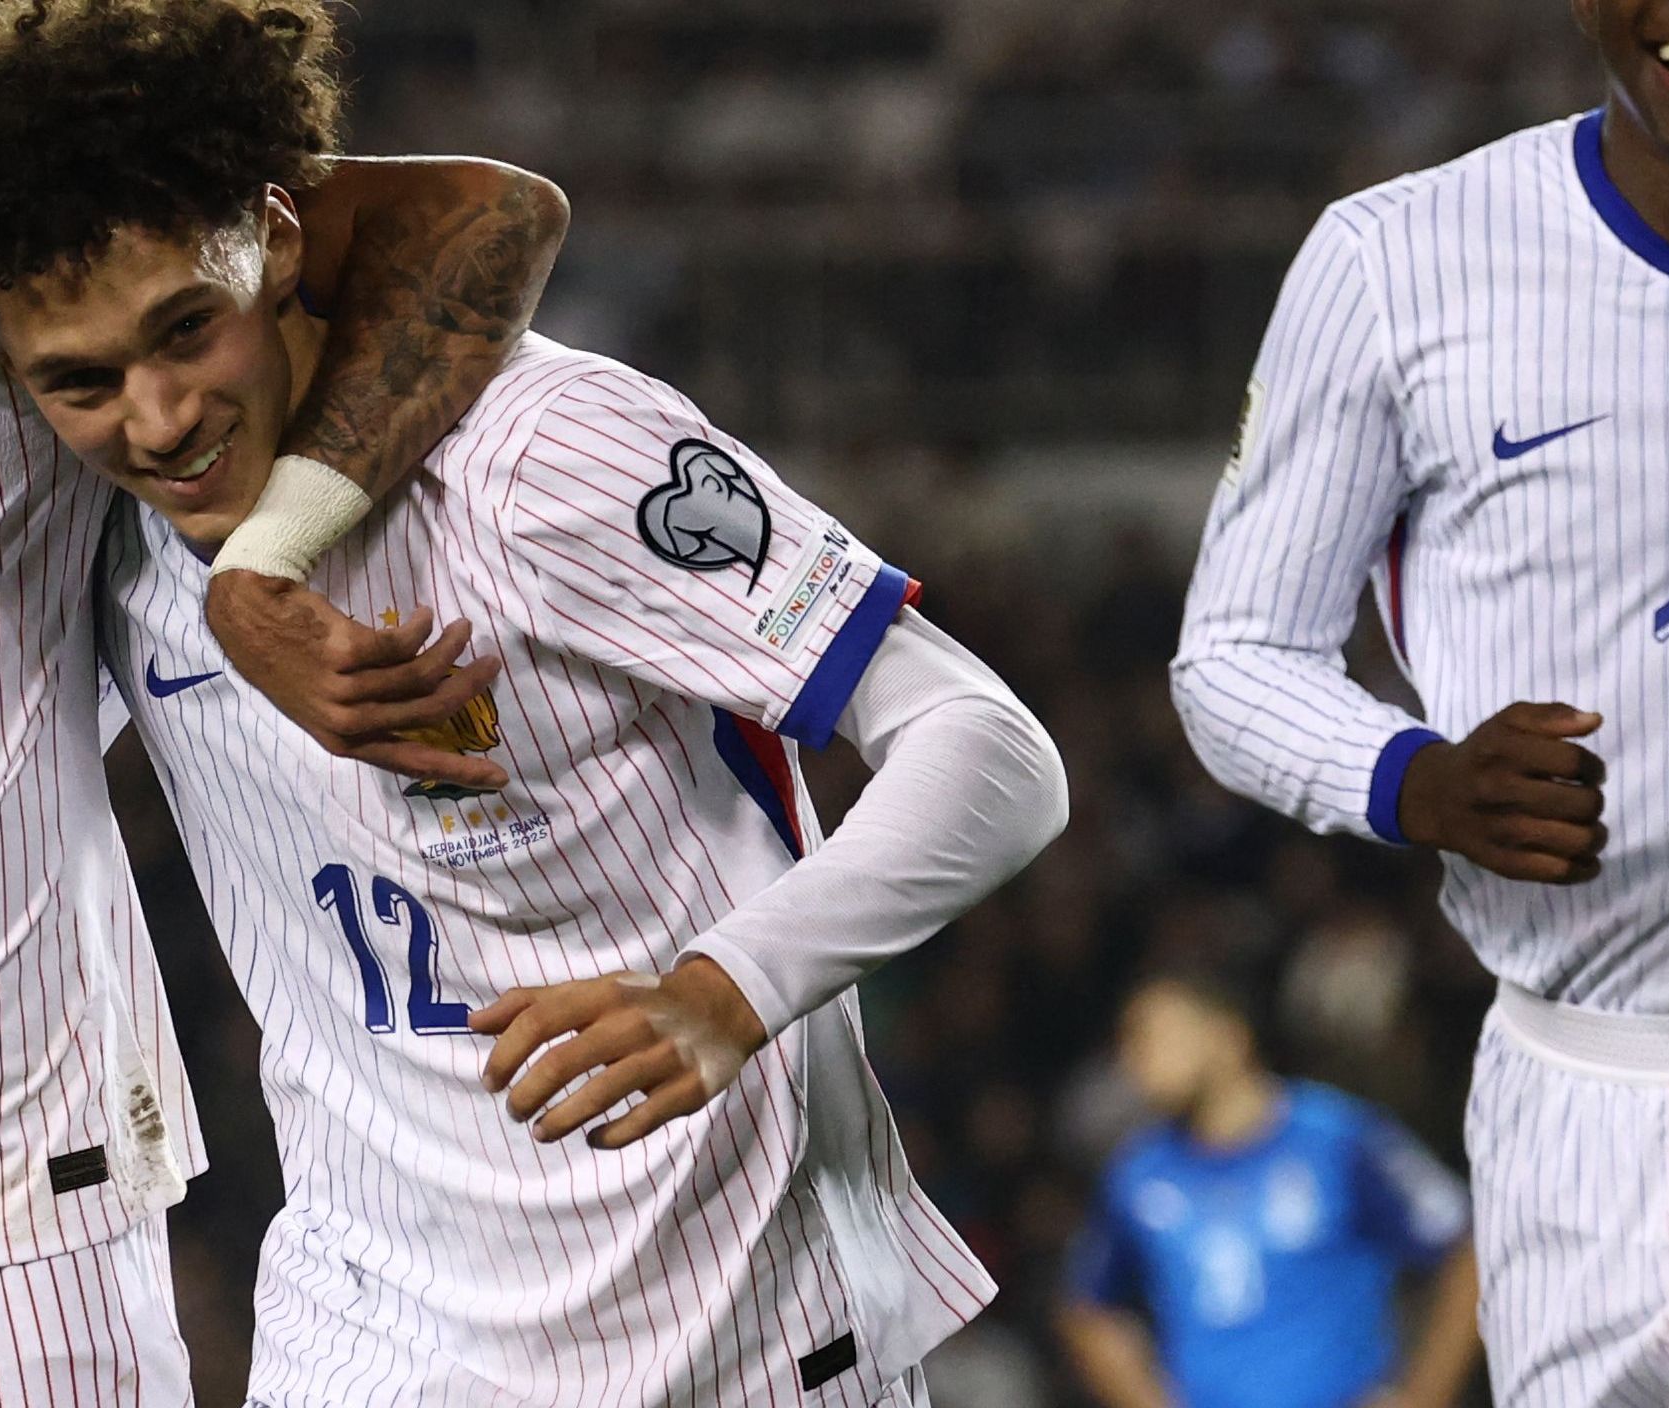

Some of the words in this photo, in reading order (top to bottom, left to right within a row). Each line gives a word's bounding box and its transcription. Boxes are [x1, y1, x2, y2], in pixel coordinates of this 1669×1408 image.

[767, 549, 839, 648] FOUNDATION
[448, 842, 510, 868] NOVEMBRE
[512, 828, 548, 850] 2025
[311, 863, 478, 1037] 12
